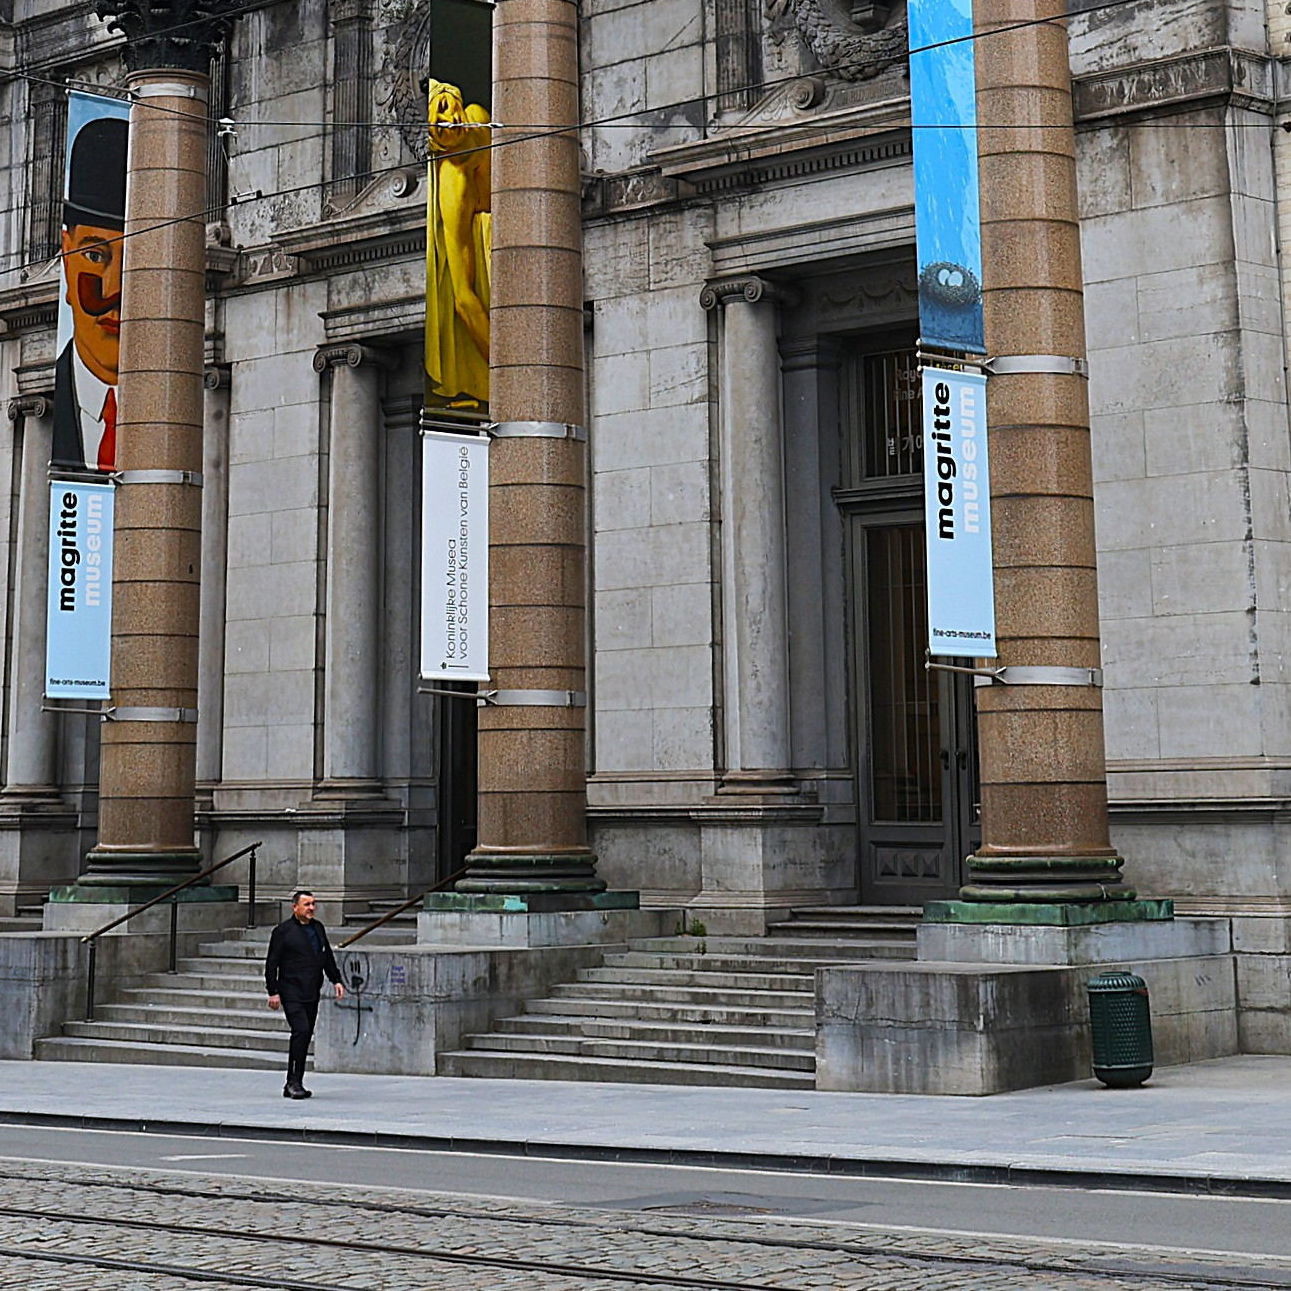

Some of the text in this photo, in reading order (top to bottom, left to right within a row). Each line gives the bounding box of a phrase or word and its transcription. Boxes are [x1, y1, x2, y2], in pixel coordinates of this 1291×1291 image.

[459, 446, 470, 487] België
[932, 382, 956, 539] magritte
[960, 387, 979, 533] museum
[57, 492, 81, 611] magritte
[86, 494, 102, 606] museum
[458, 518, 468, 570] Kunsten
[446, 539, 457, 659] Koninklijke Musea
[458, 573, 468, 626] Schone
[49, 678, 106, 687] fine-arts-museum.be
[460, 627, 468, 660] voor
